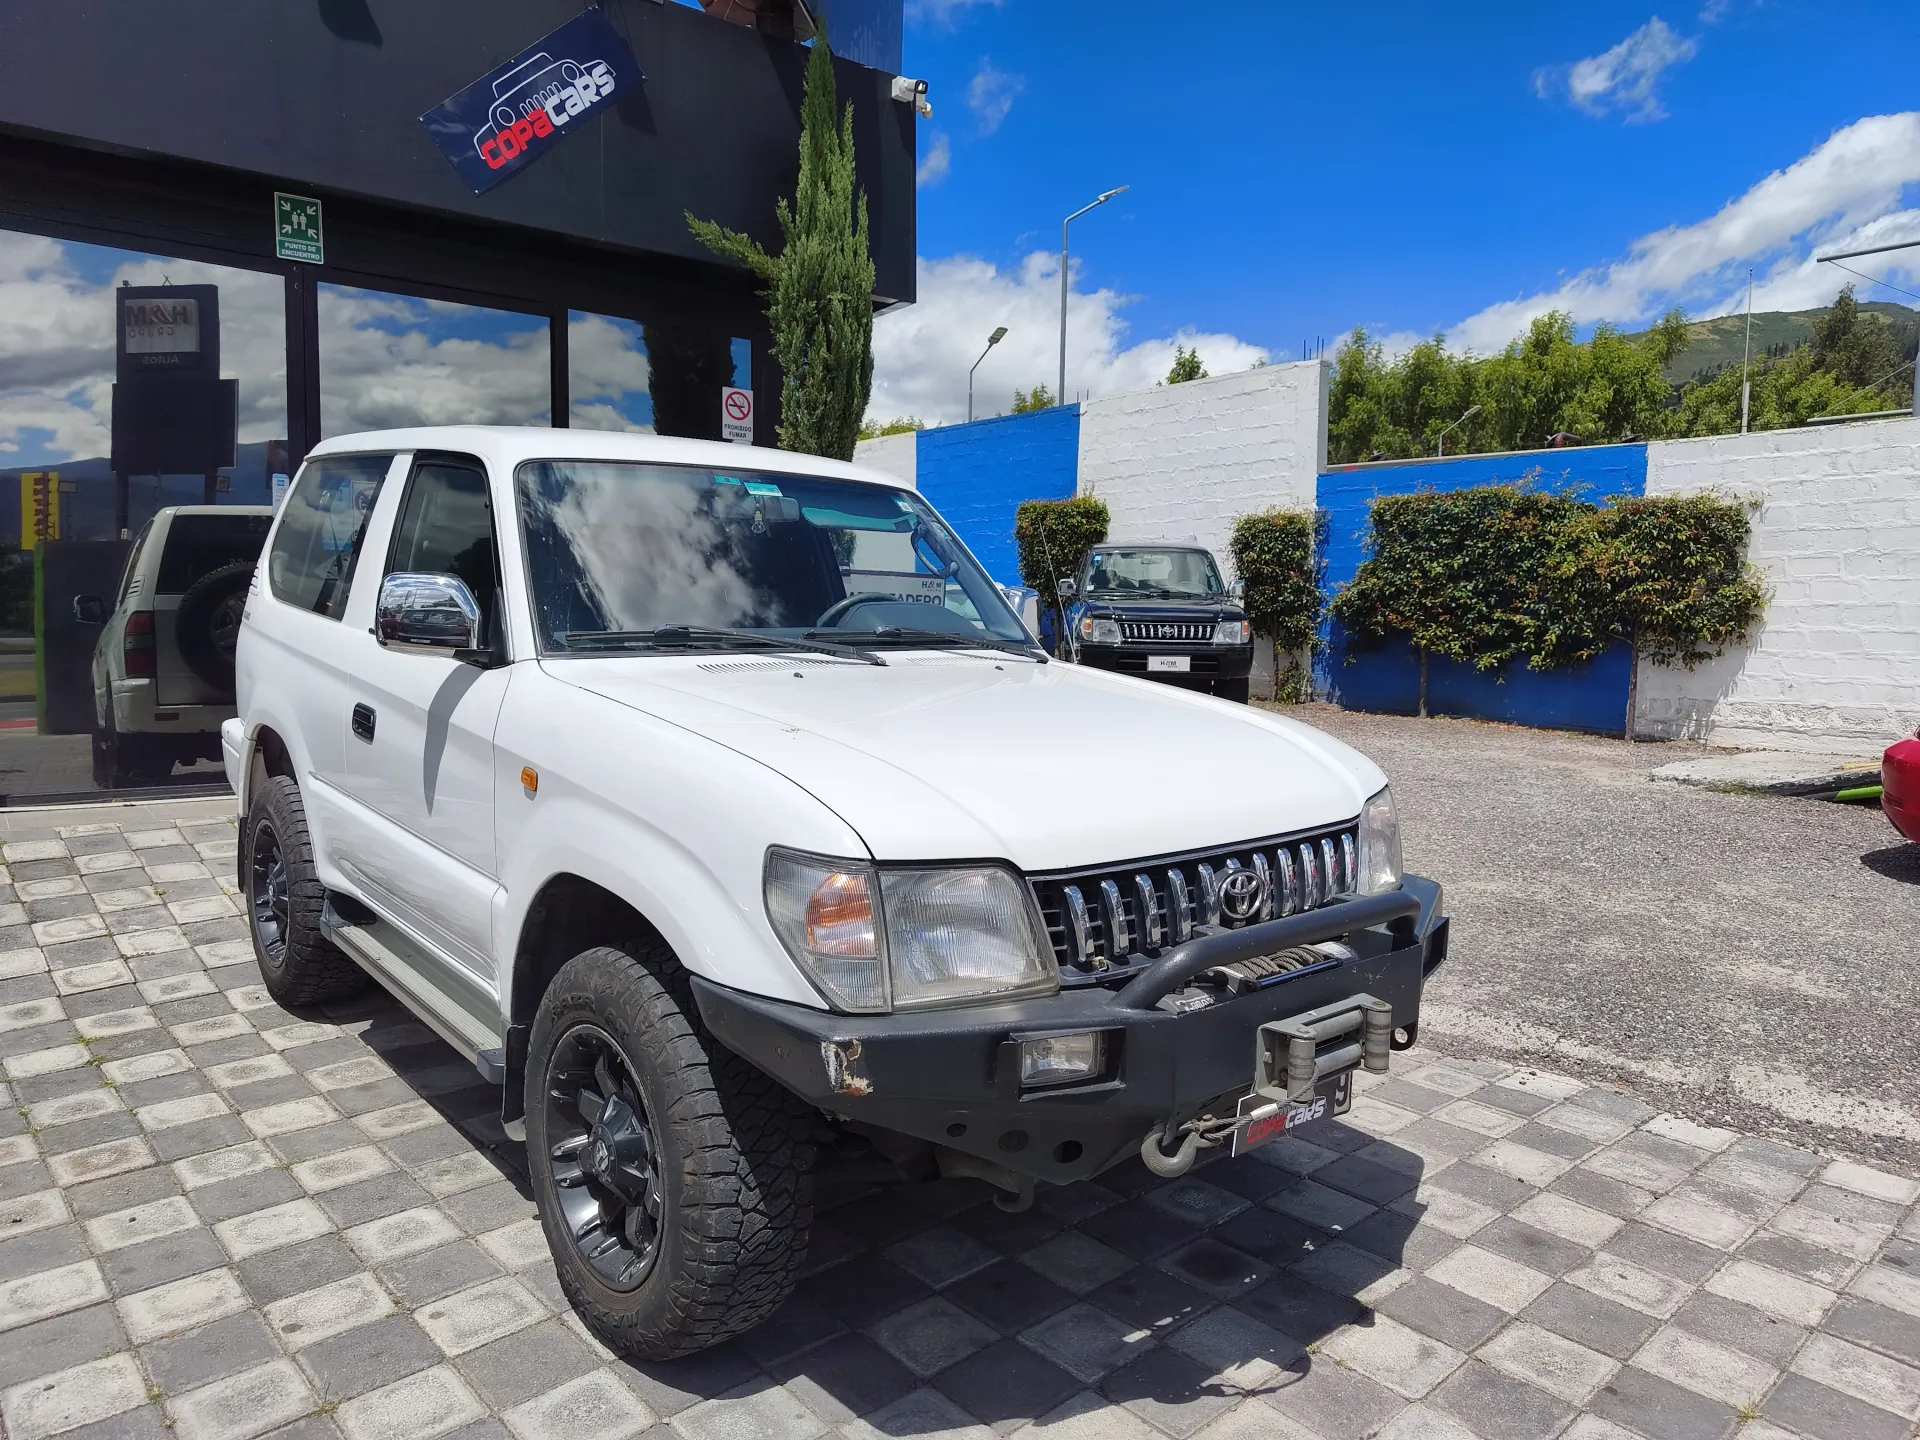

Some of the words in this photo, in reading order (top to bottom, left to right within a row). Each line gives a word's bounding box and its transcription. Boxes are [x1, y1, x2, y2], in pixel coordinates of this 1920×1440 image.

[284, 242, 307, 251] PUNTO
[281, 249, 320, 260] ENCUENTRO
[724, 423, 752, 433] PROHIBIDO
[729, 431, 747, 439] FUMAR
